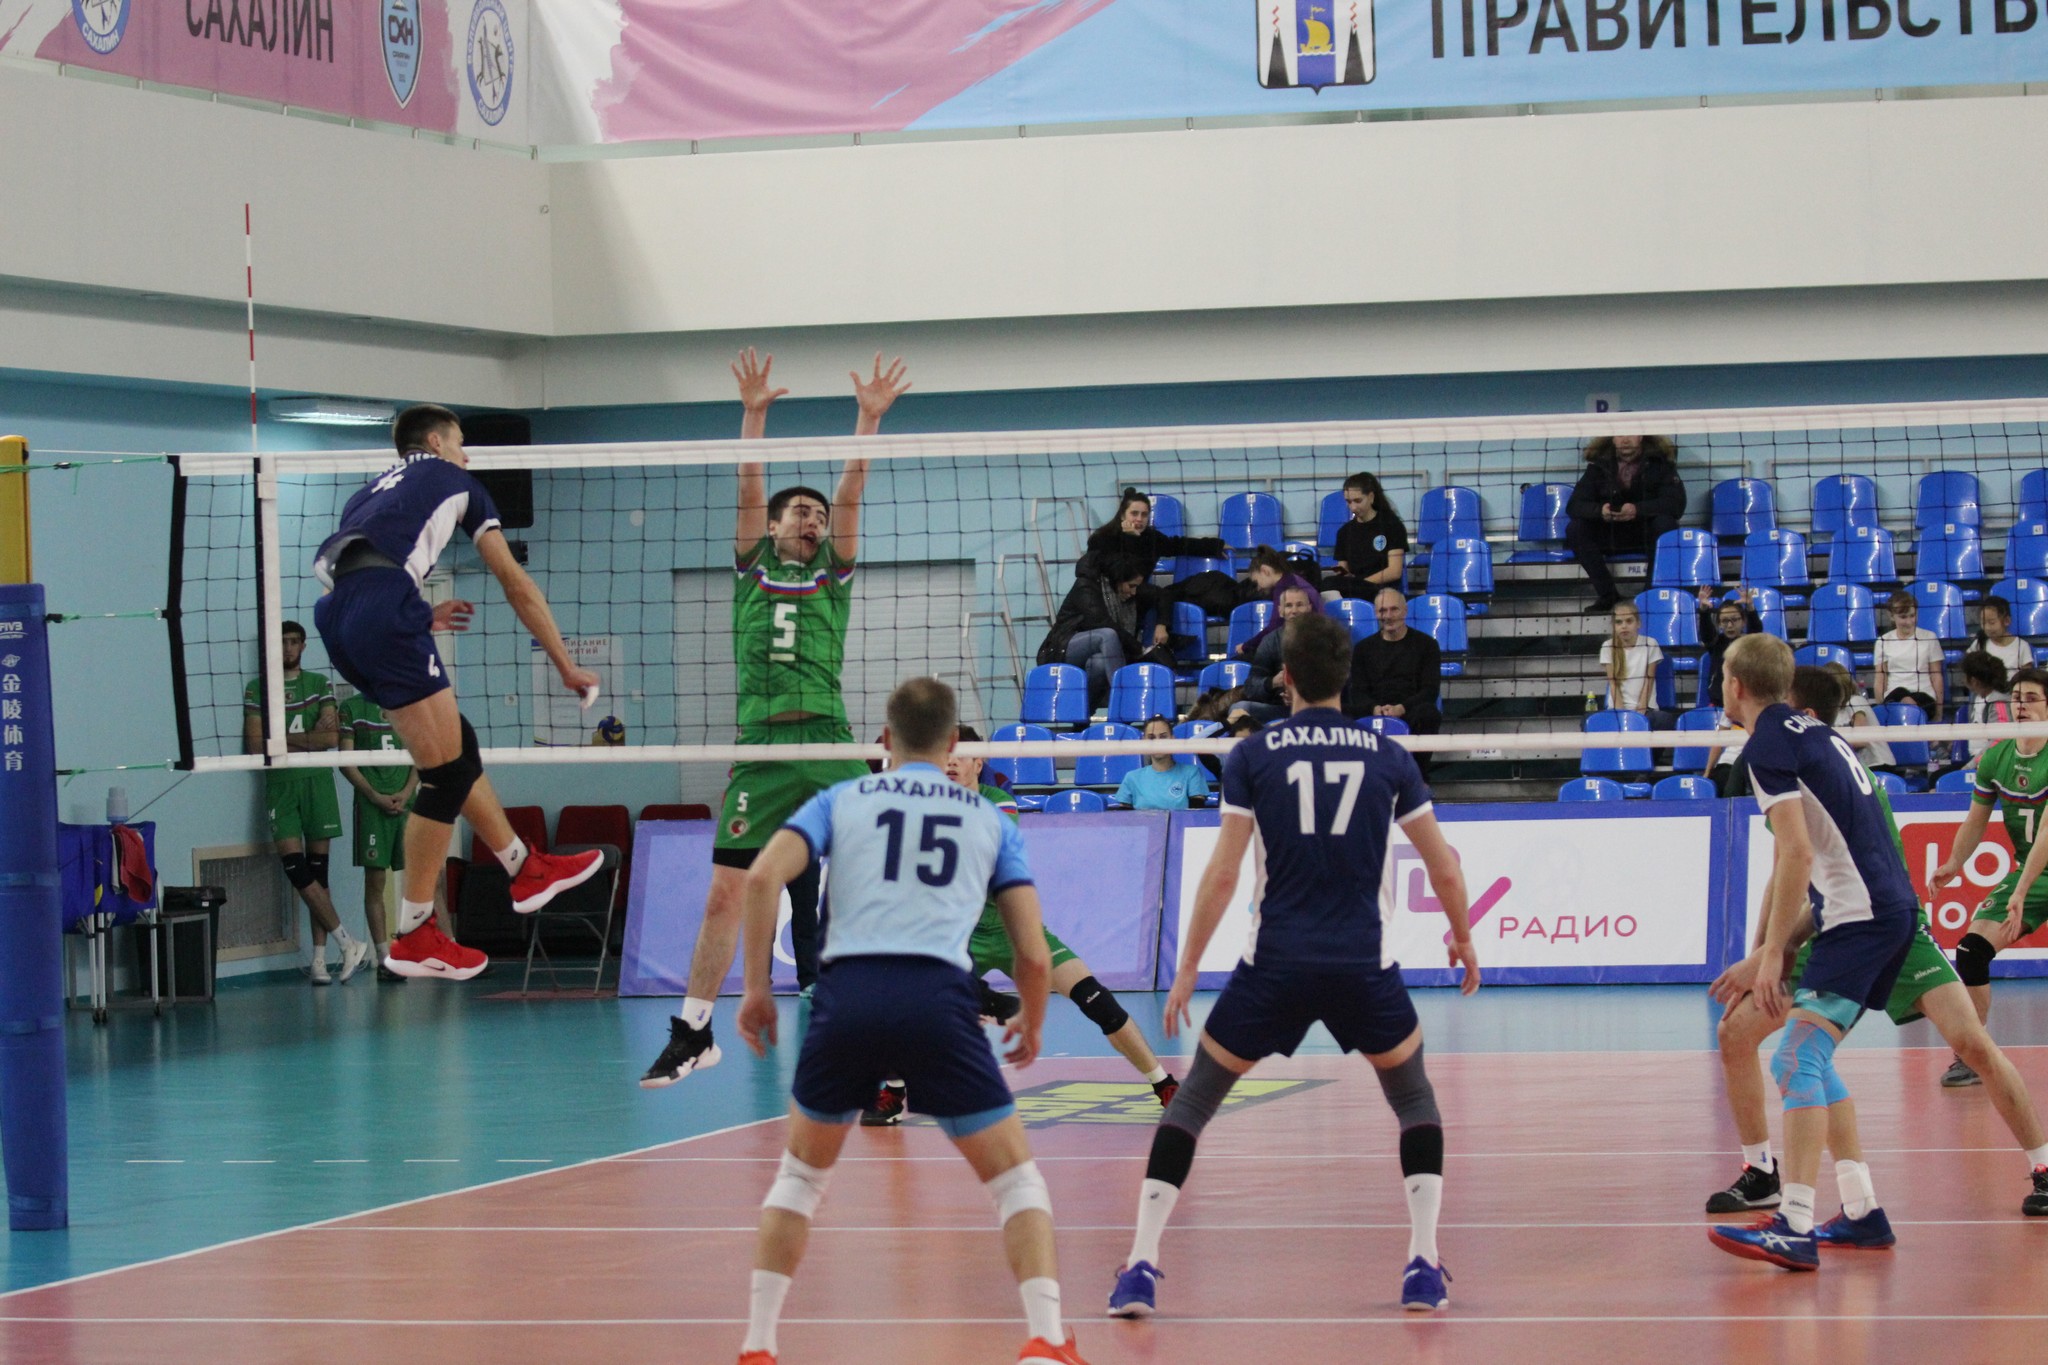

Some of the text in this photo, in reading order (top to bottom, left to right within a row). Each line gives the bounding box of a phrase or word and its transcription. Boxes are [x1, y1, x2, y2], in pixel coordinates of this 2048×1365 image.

[82, 22, 120, 51] САХАЛИН
[186, 0, 334, 63] САХАЛИН
[1431, 0, 2048, 58] ПРАВИТЕЛЬСТВ
[772, 602, 798, 649] 5
[429, 654, 441, 678] 4
[567, 647, 599, 655] НЯТИЙ
[2, 673, 24, 772] 金陵体育
[1265, 726, 1379, 752] САХАЛИН
[1829, 735, 1873, 796] 8
[737, 791, 749, 812] 5
[860, 777, 980, 808] САХАЛИН
[1286, 760, 1366, 836] 17
[369, 834, 376, 846] 6
[876, 808, 963, 887] 15
[1926, 841, 2012, 888] LO
[1499, 914, 1638, 944] РАДИО
